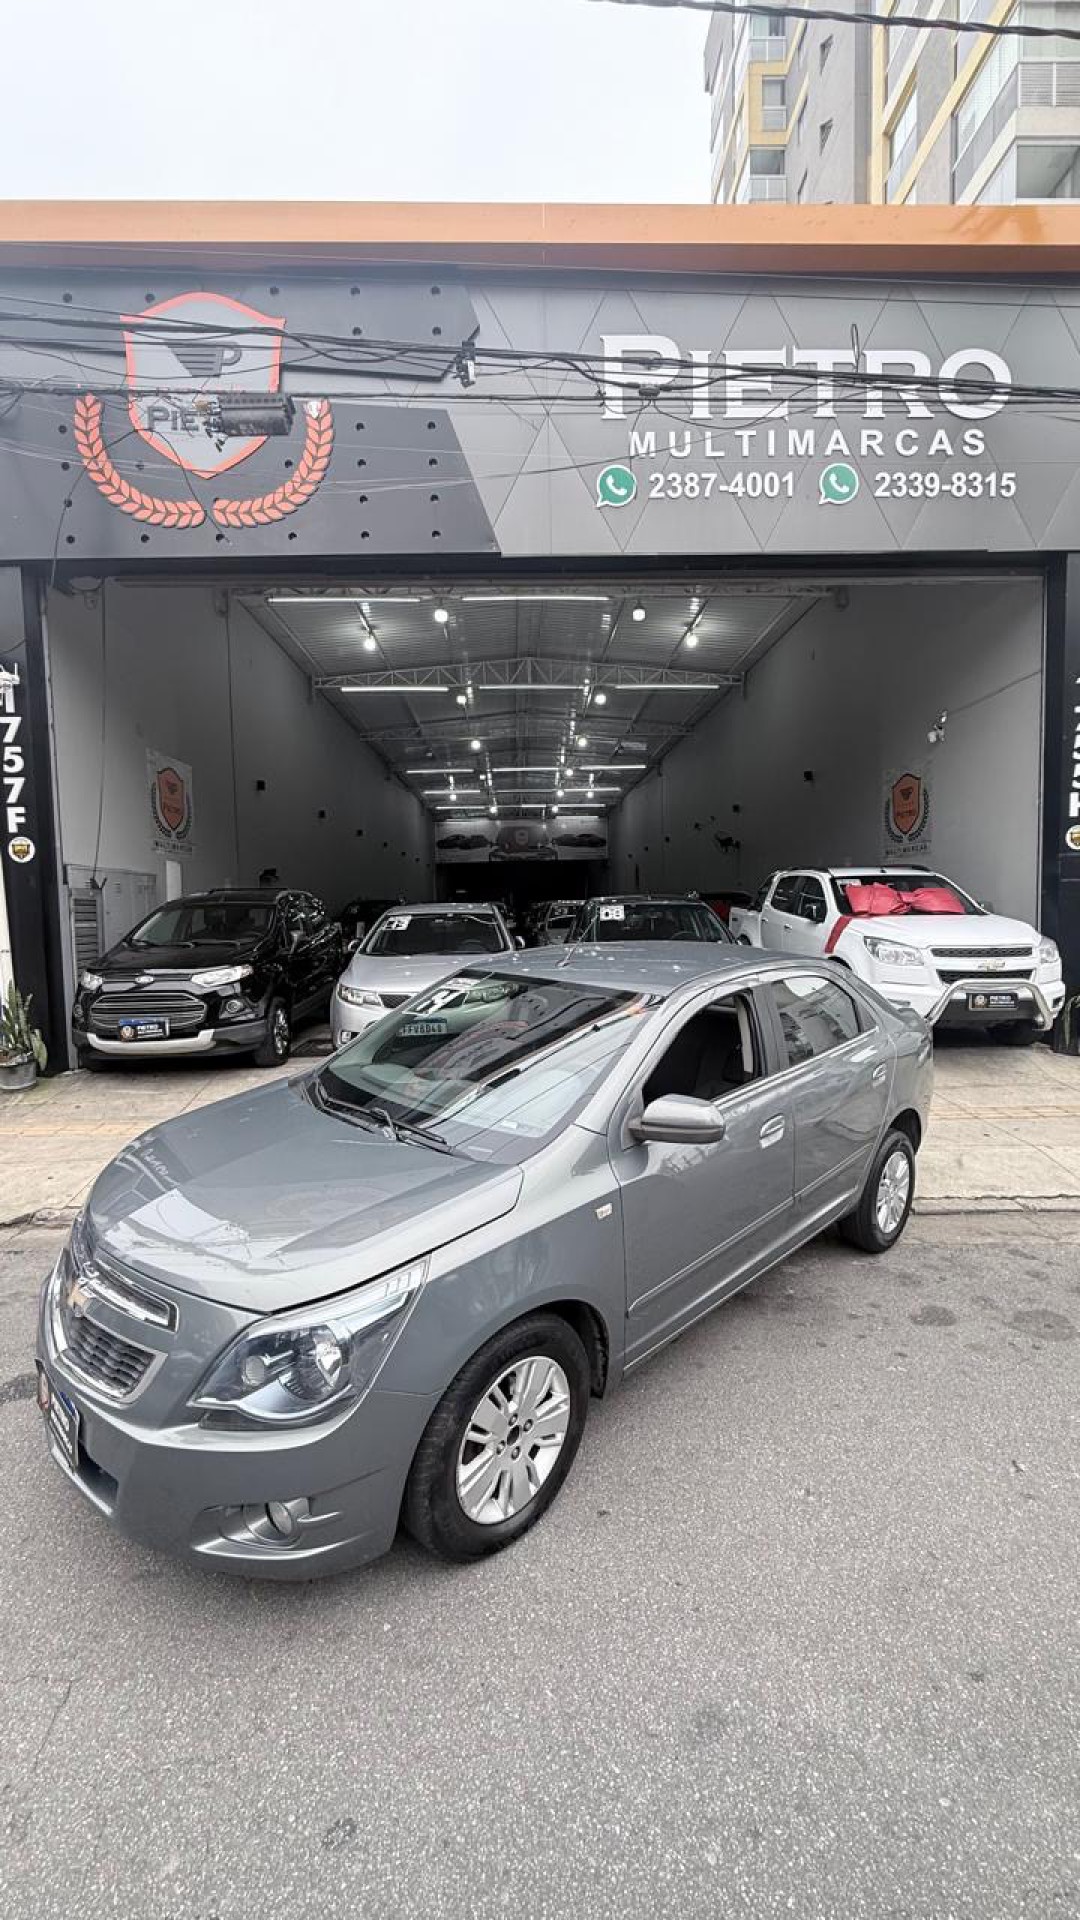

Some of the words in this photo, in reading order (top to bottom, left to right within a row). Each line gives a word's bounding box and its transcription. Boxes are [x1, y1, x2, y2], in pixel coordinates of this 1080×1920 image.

[600, 334, 1012, 420] PIETRO
[630, 429, 985, 457] MULTIMARCAS
[648, 471, 794, 498] 2387-4001
[874, 470, 1016, 498] 2339-8315
